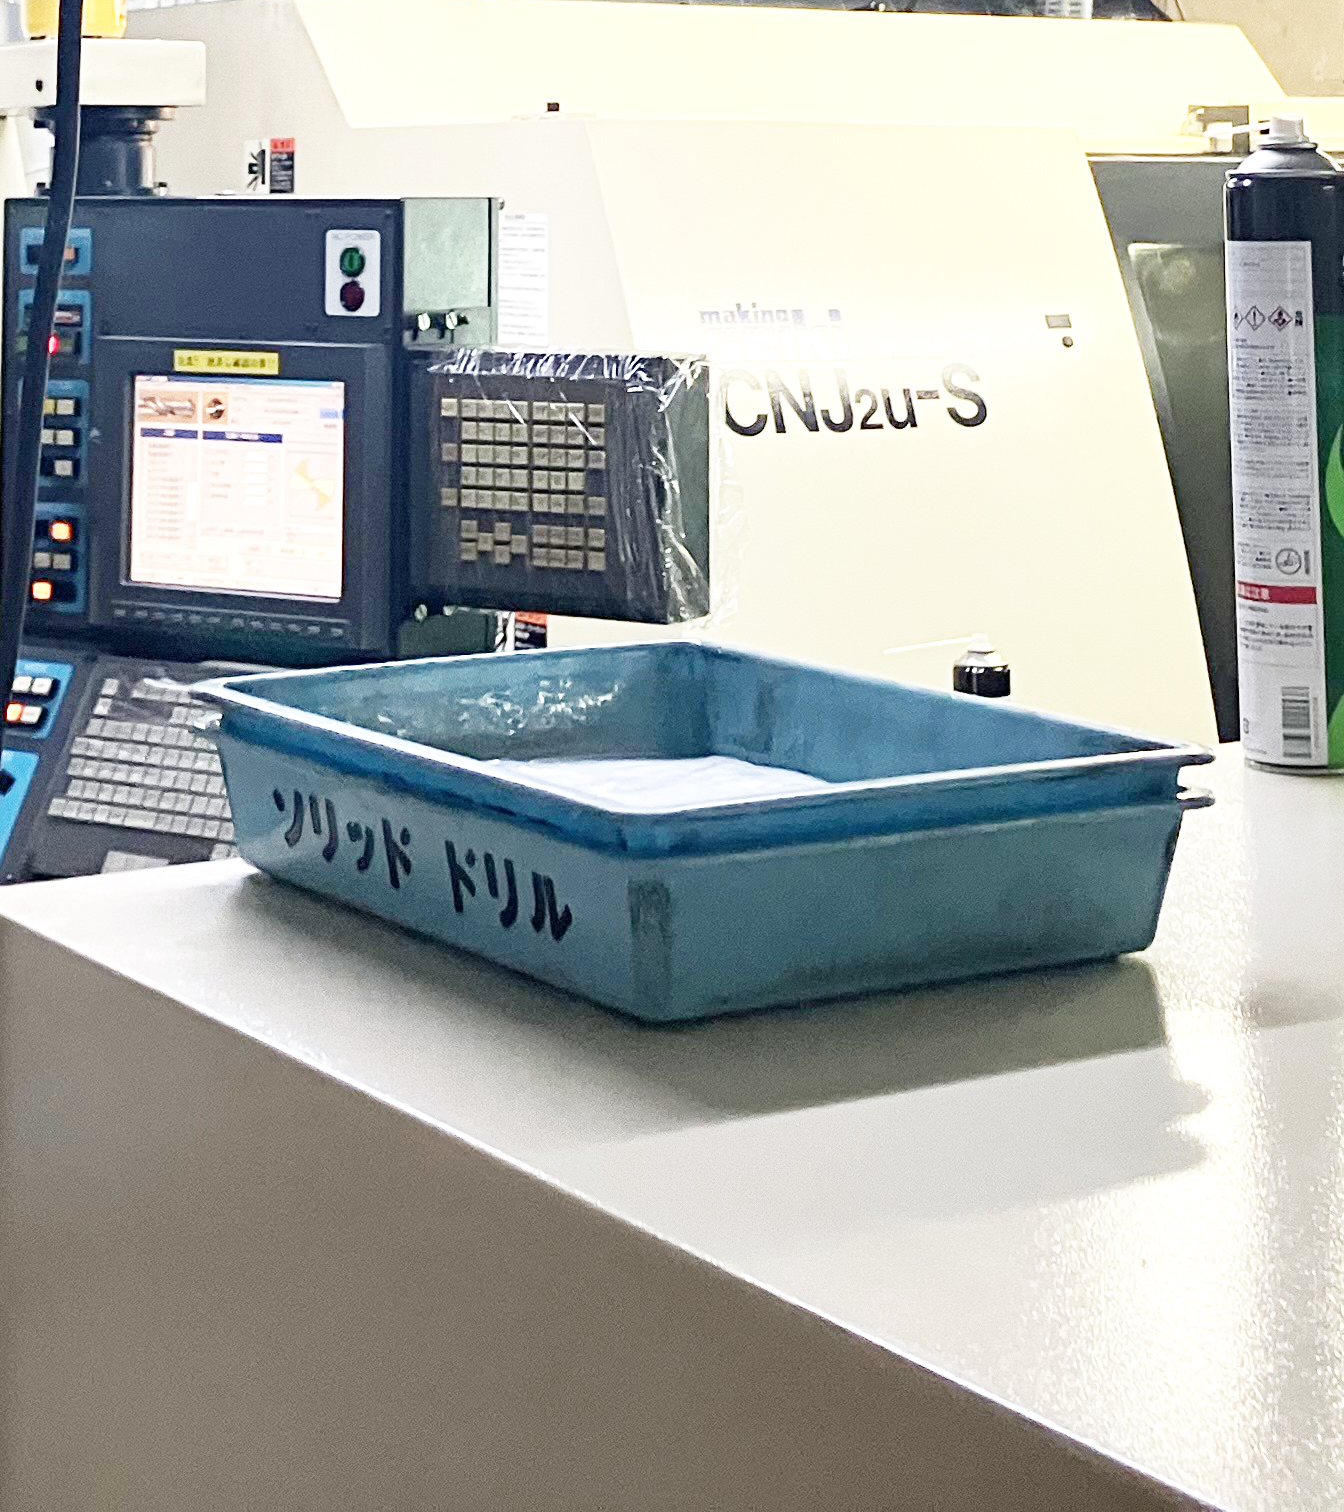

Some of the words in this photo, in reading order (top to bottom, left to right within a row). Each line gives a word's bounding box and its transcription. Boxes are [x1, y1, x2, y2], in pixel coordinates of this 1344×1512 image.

[272, 787, 412, 890] ソリッド
[444, 839, 573, 943] ドリル
